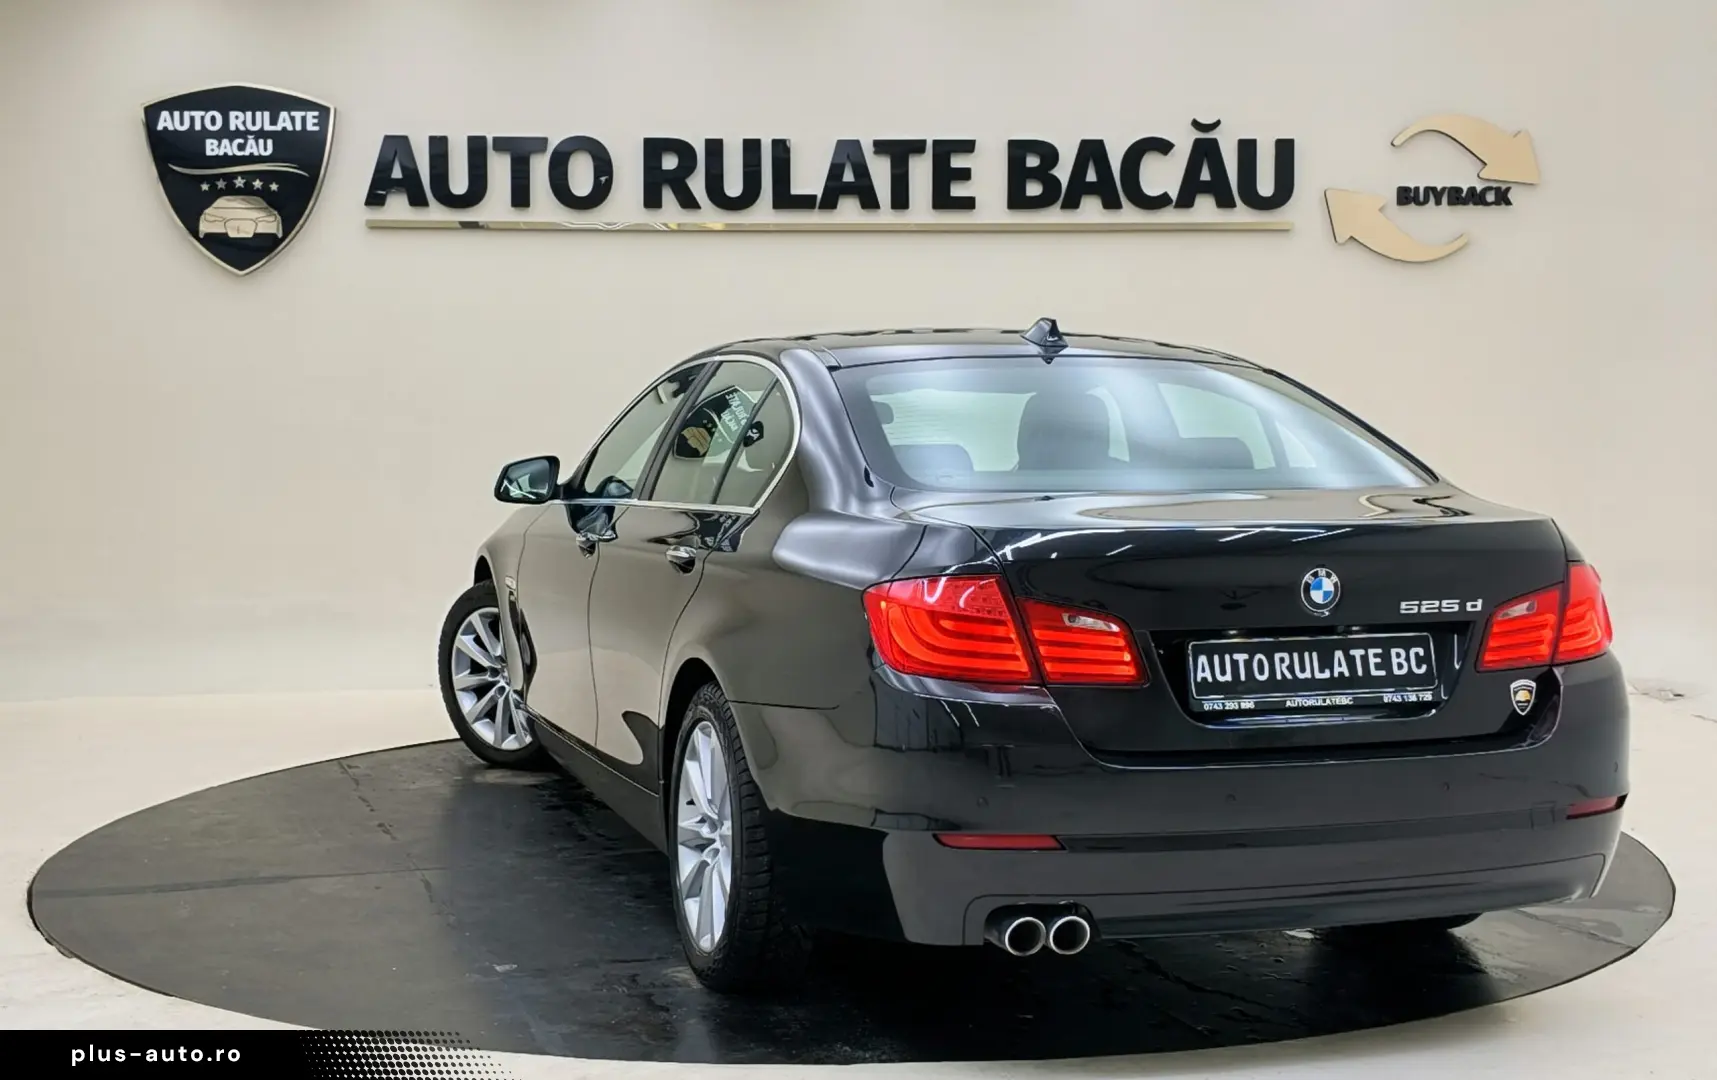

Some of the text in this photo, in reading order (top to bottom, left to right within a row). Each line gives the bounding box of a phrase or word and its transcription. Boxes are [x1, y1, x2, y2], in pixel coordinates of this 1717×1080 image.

[157, 110, 320, 131] AUTO RULATE
[205, 135, 273, 156] BACĂU
[364, 117, 1296, 211] AUTO RULATE BACĂU
[1396, 185, 1513, 207] BUYBACK
[1399, 598, 1483, 614] 525 d
[1196, 647, 1428, 683] AUTO RULATE BC
[1285, 696, 1355, 708] AUTORULATEBC
